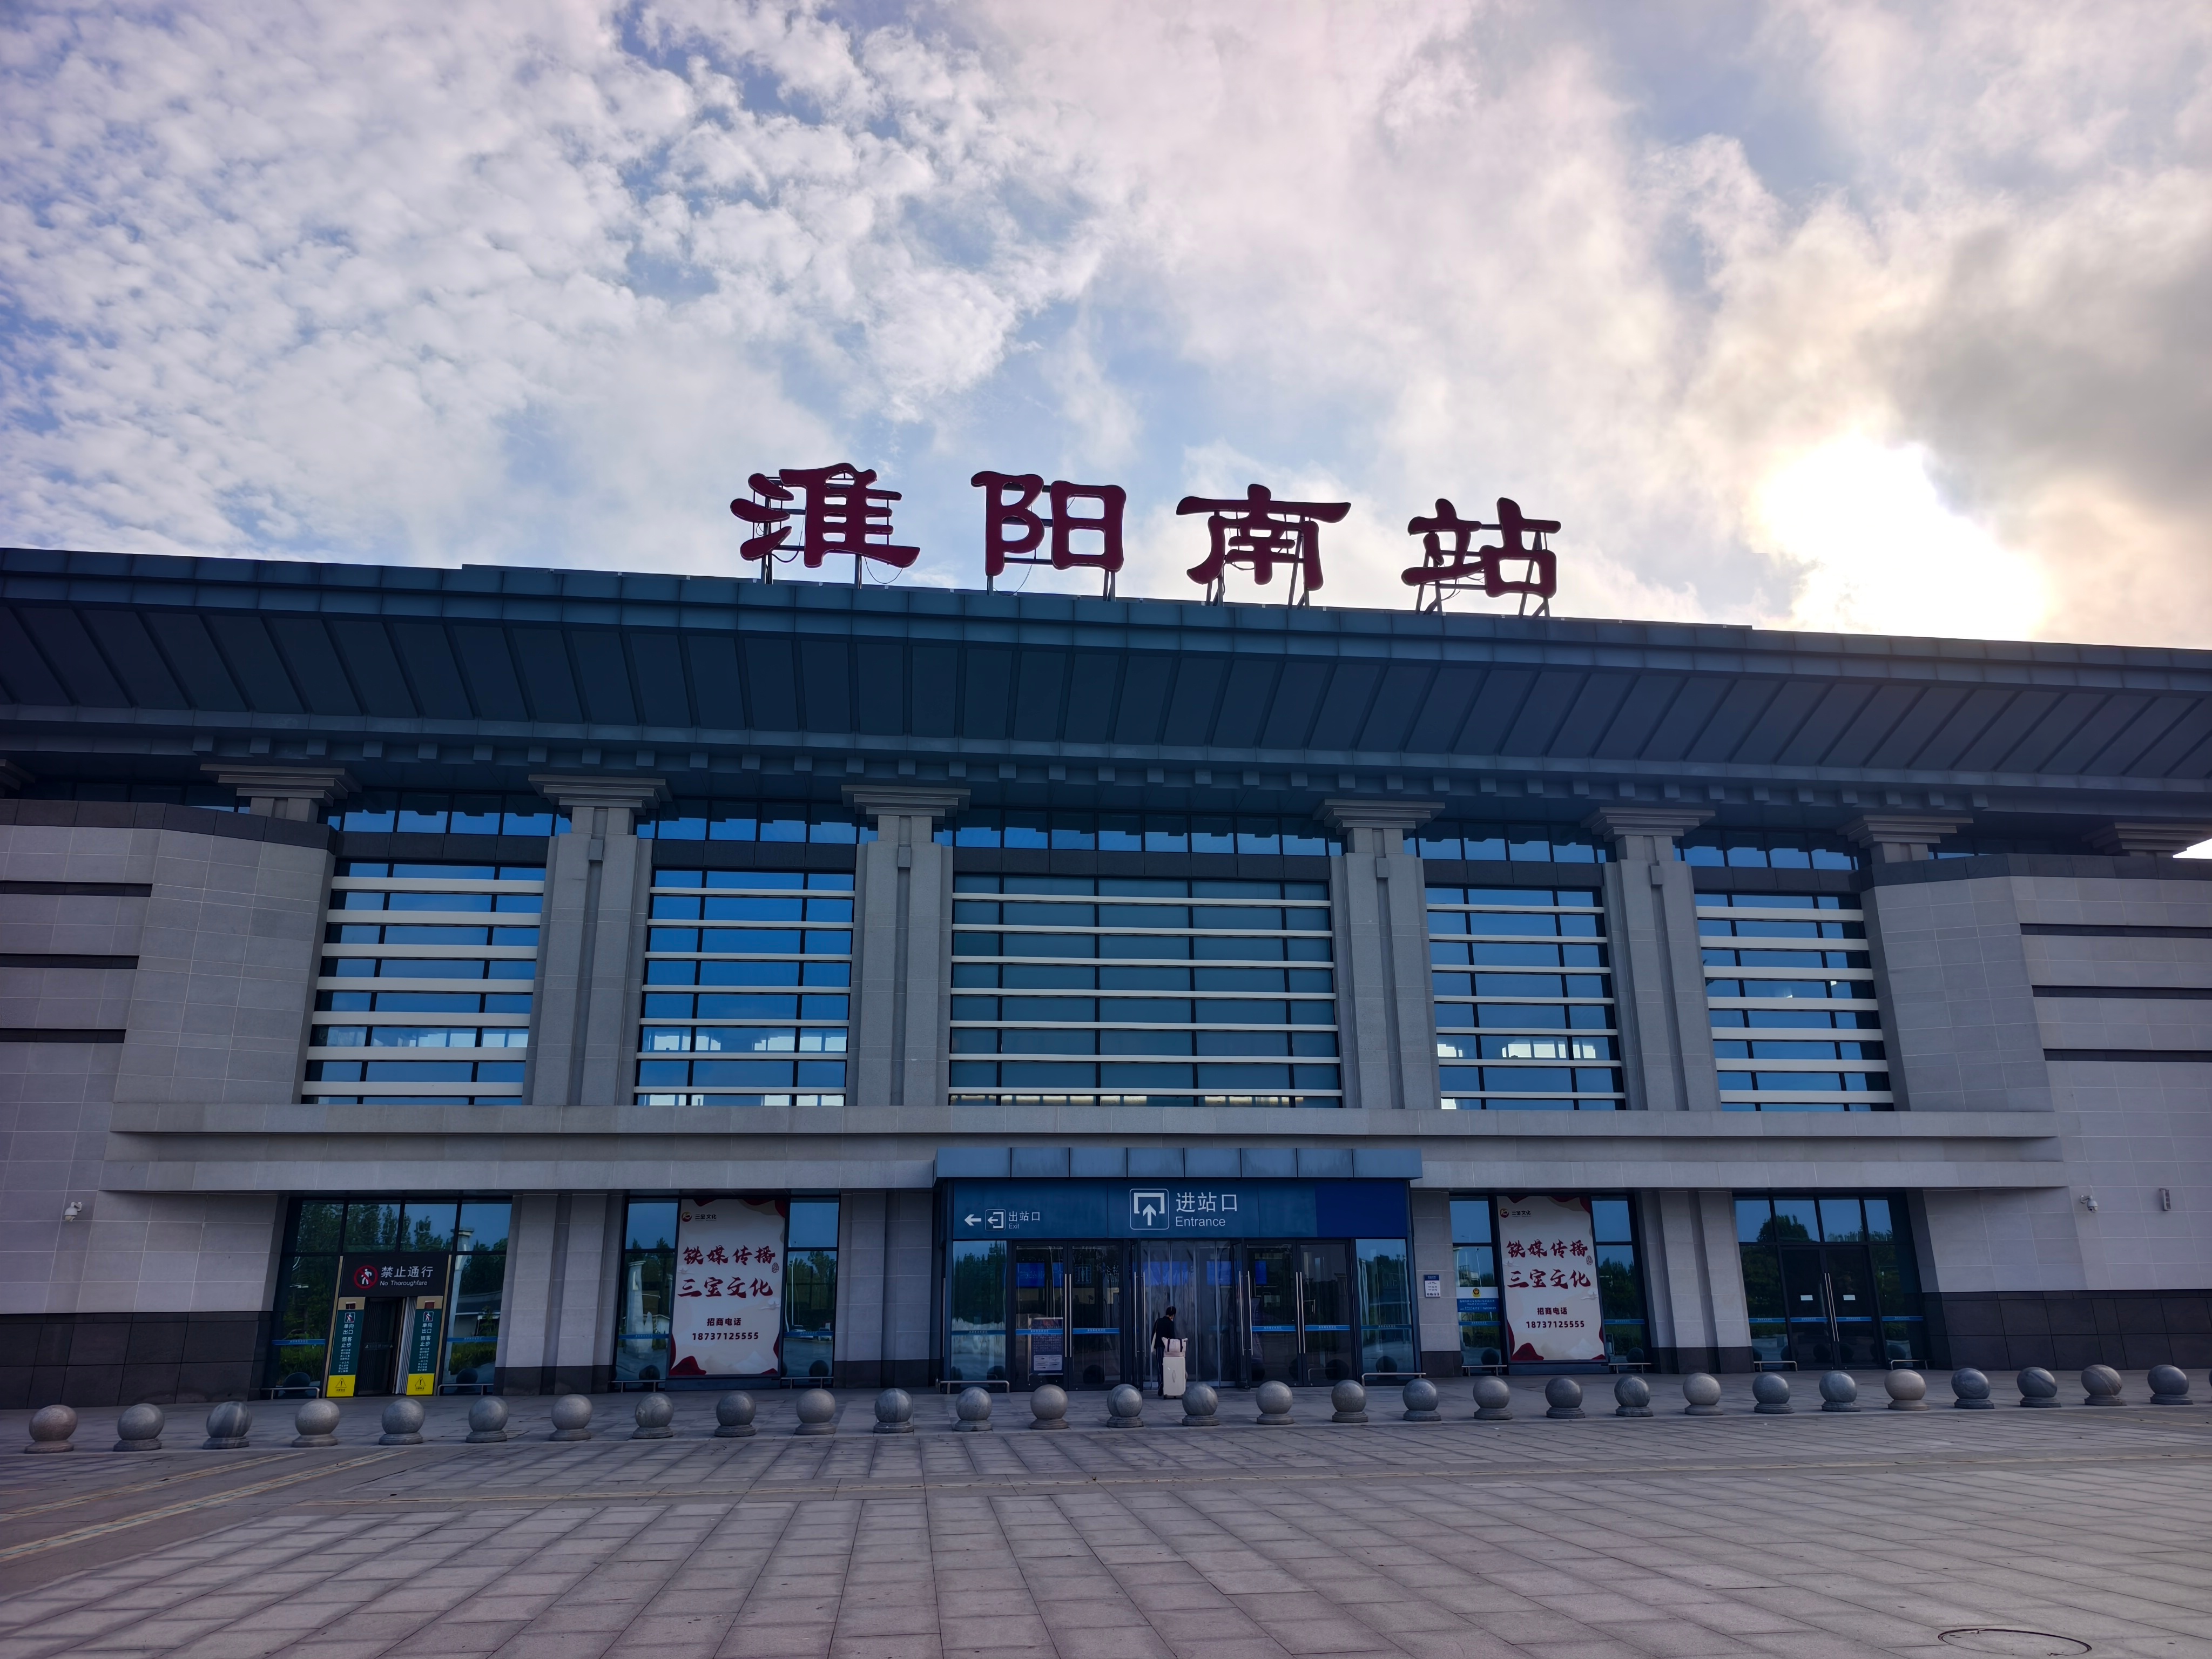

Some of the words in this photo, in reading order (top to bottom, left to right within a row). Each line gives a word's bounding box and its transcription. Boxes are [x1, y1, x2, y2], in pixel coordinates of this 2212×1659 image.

[730, 463, 1562, 598] 淮阳南站
[1176, 1192, 1237, 1212] 进站口
[1008, 1211, 1040, 1222] 出站口
[1176, 1216, 1226, 1226] Entrance
[1506, 1239, 1588, 1258] 铁媒传播
[683, 1245, 775, 1265] 铁媒传播
[381, 1266, 433, 1278] 禁止通行
[1507, 1269, 1591, 1289] 三宝文化
[677, 1276, 773, 1298] 三宝文化
[1537, 1307, 1568, 1315] 招商电话
[707, 1318, 741, 1326] 招商电话
[1526, 1320, 1584, 1328] 18737125555
[692, 1332, 759, 1340] 18737125555
